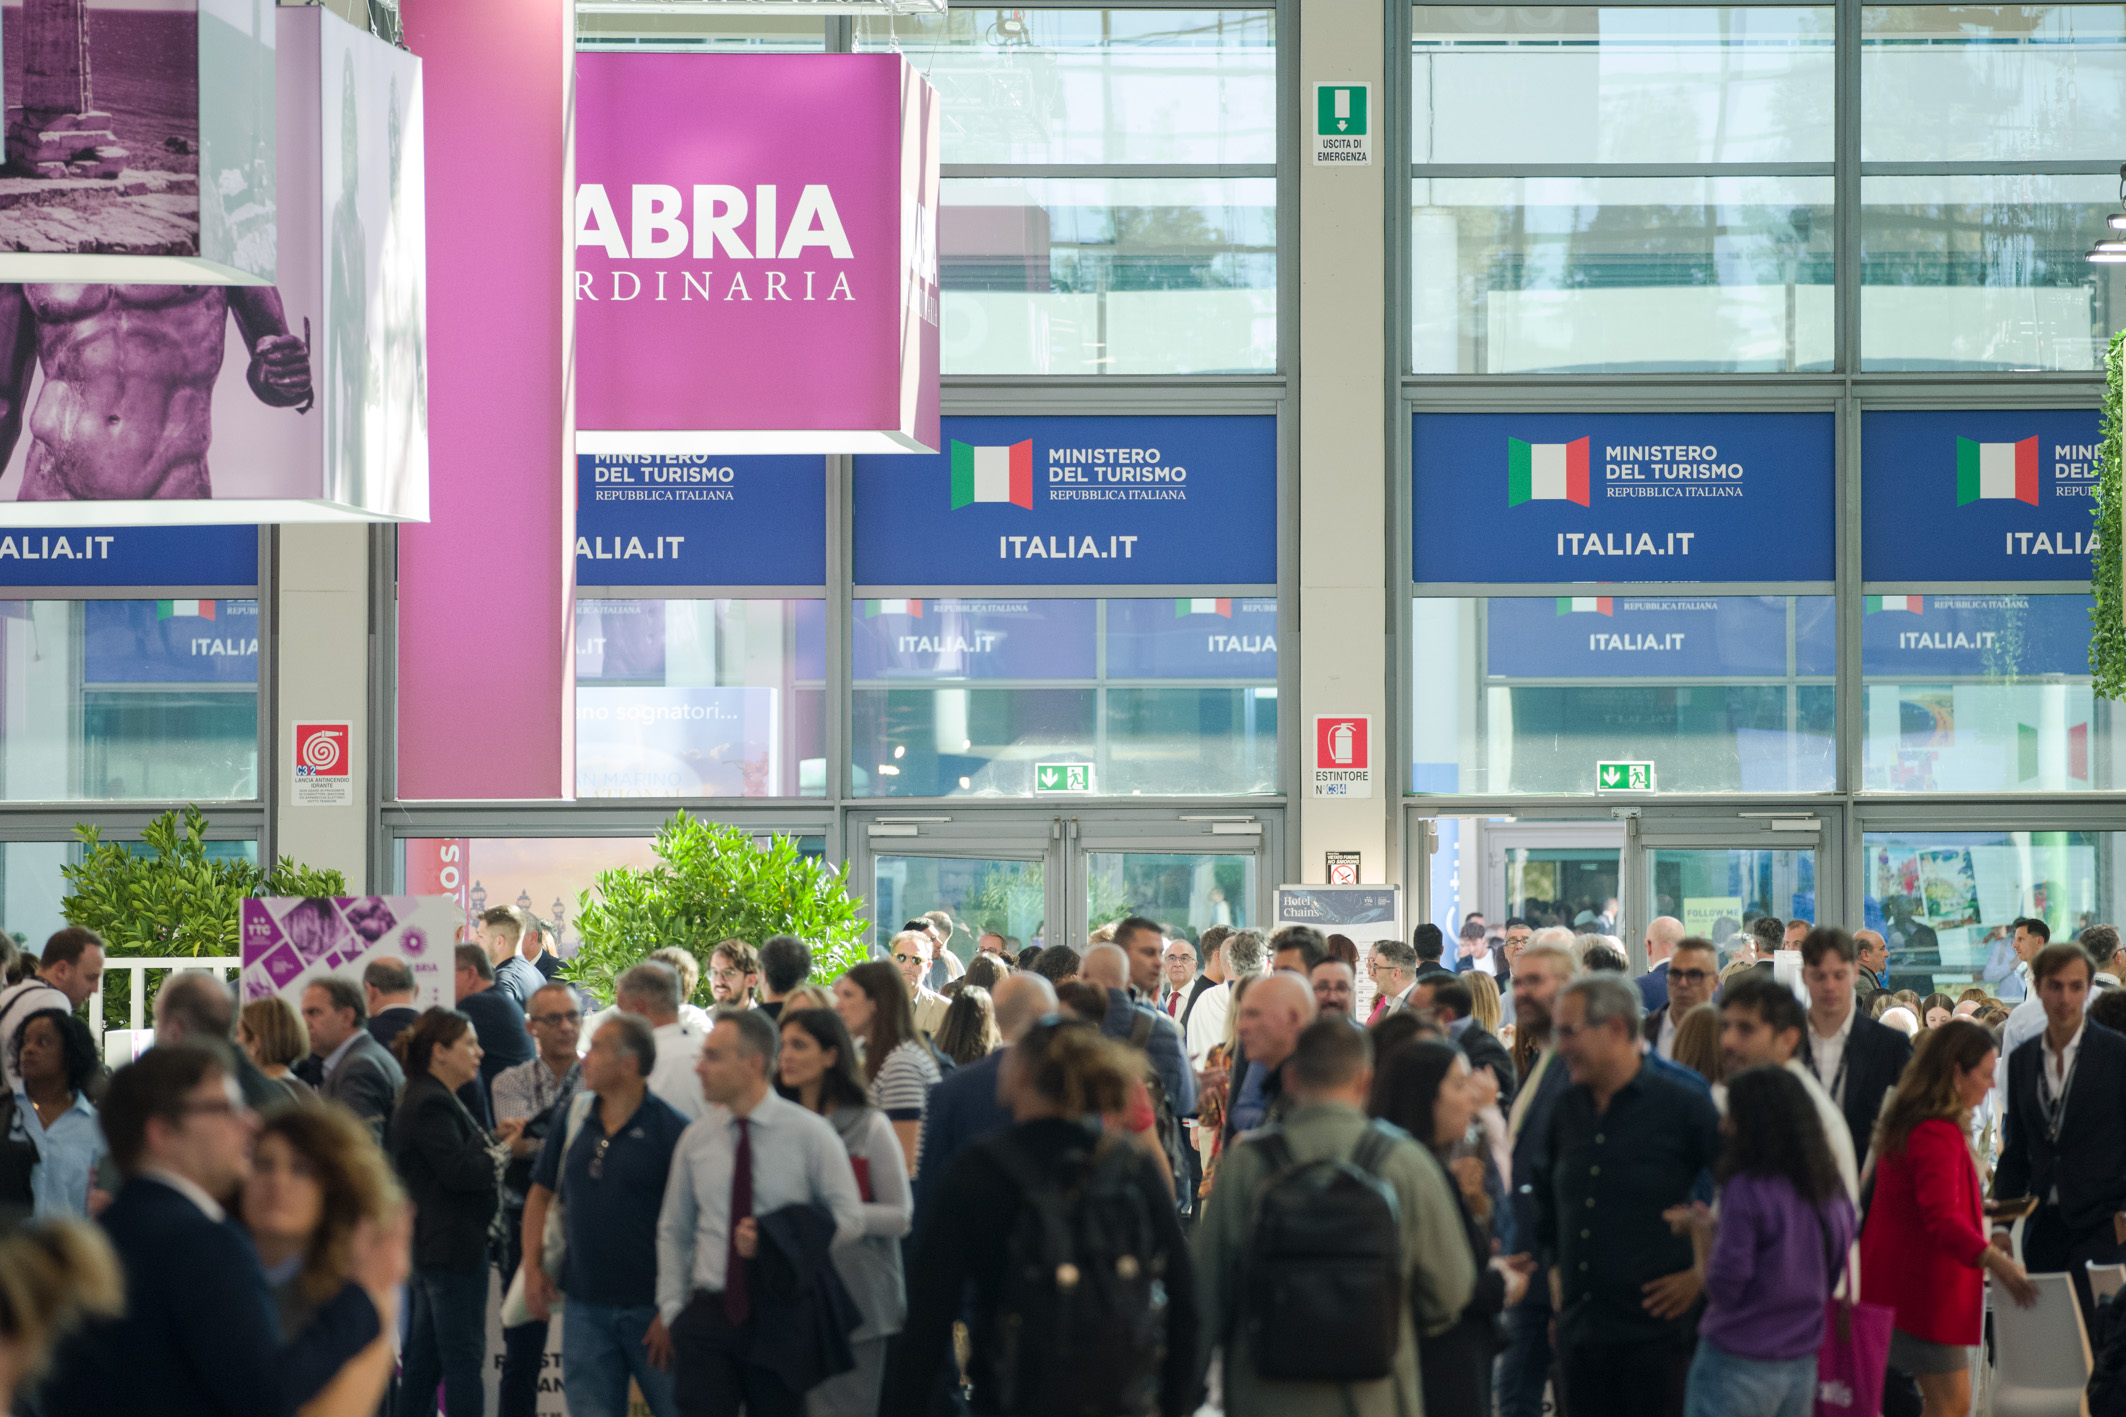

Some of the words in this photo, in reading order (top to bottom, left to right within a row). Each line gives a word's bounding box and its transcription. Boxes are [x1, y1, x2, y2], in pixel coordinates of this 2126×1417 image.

[1322, 139, 1352, 149] USCITA
[1353, 139, 1362, 149] DI
[1317, 152, 1367, 161] EMERGENZA
[1049, 448, 1161, 464] MINISTERO
[1606, 445, 1718, 461] MINISTERO
[595, 466, 635, 482] DEL
[641, 466, 735, 482] TURISMO
[1049, 467, 1089, 482] DEL
[1094, 466, 1187, 482] TURISMO
[1606, 464, 1645, 479] DEL
[1651, 463, 1744, 479] TURISMO
[2055, 463, 2095, 478] DEL
[595, 490, 674, 501] REPUBBLICA
[676, 490, 734, 501] ITALIANA
[1049, 490, 1126, 500] REPUBBLICA
[1128, 489, 1187, 500] ITALIANA
[1606, 487, 1683, 498] REPUBBLICA
[1685, 486, 1743, 497] ITALIANA
[1000, 536, 1138, 559] ITALIA.IT
[1557, 532, 1695, 556] ITALIA.IT
[933, 604, 987, 613] REPUBBLICA
[988, 604, 1029, 613] ITALIANA
[1624, 602, 1677, 611] REPUBBLICA
[1678, 602, 1718, 610] ITALIANA
[1934, 600, 1987, 609] REPUBBLICA
[1988, 600, 2029, 609] ITALIANA
[899, 635, 996, 653] ITALIA.IT
[1589, 633, 1685, 651] ITALIA.IT
[1899, 632, 1996, 649] ITALIA.IT
[1315, 771, 1369, 781] ESTINTORE
[1283, 896, 1311, 906] Hotel
[1283, 907, 1320, 918] Chains
[1687, 908, 1724, 917] FOLLOW
[1726, 908, 1739, 917] ME
